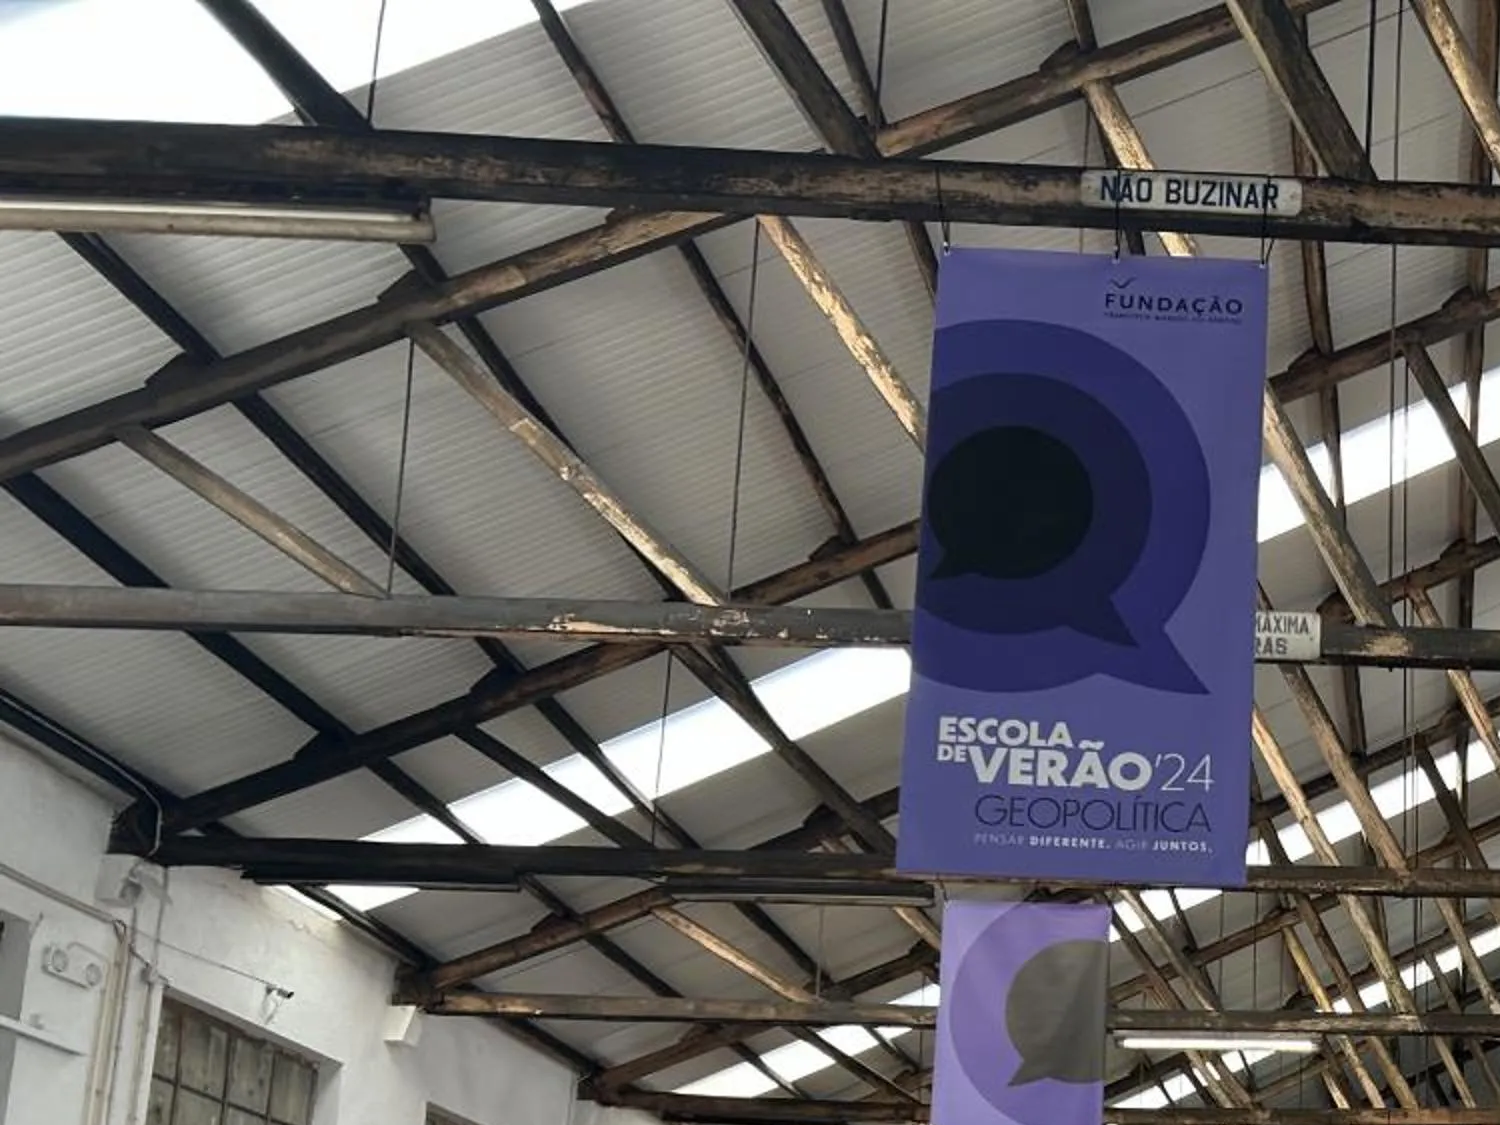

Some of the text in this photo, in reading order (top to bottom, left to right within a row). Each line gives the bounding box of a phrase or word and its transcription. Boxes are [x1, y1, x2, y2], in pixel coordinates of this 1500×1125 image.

[1101, 173, 1280, 209] NÃO BUZINAR
[1104, 293, 1243, 316] FUNDAÇÃO
[938, 716, 1075, 749] ESCOLA
[936, 744, 967, 763] DE
[967, 740, 1153, 791] VERÃO
[974, 794, 1212, 833] GEOPOLÍTICA
[1029, 835, 1111, 849] DIFERENTE.
[1151, 839, 1214, 853] JUNTOS.
